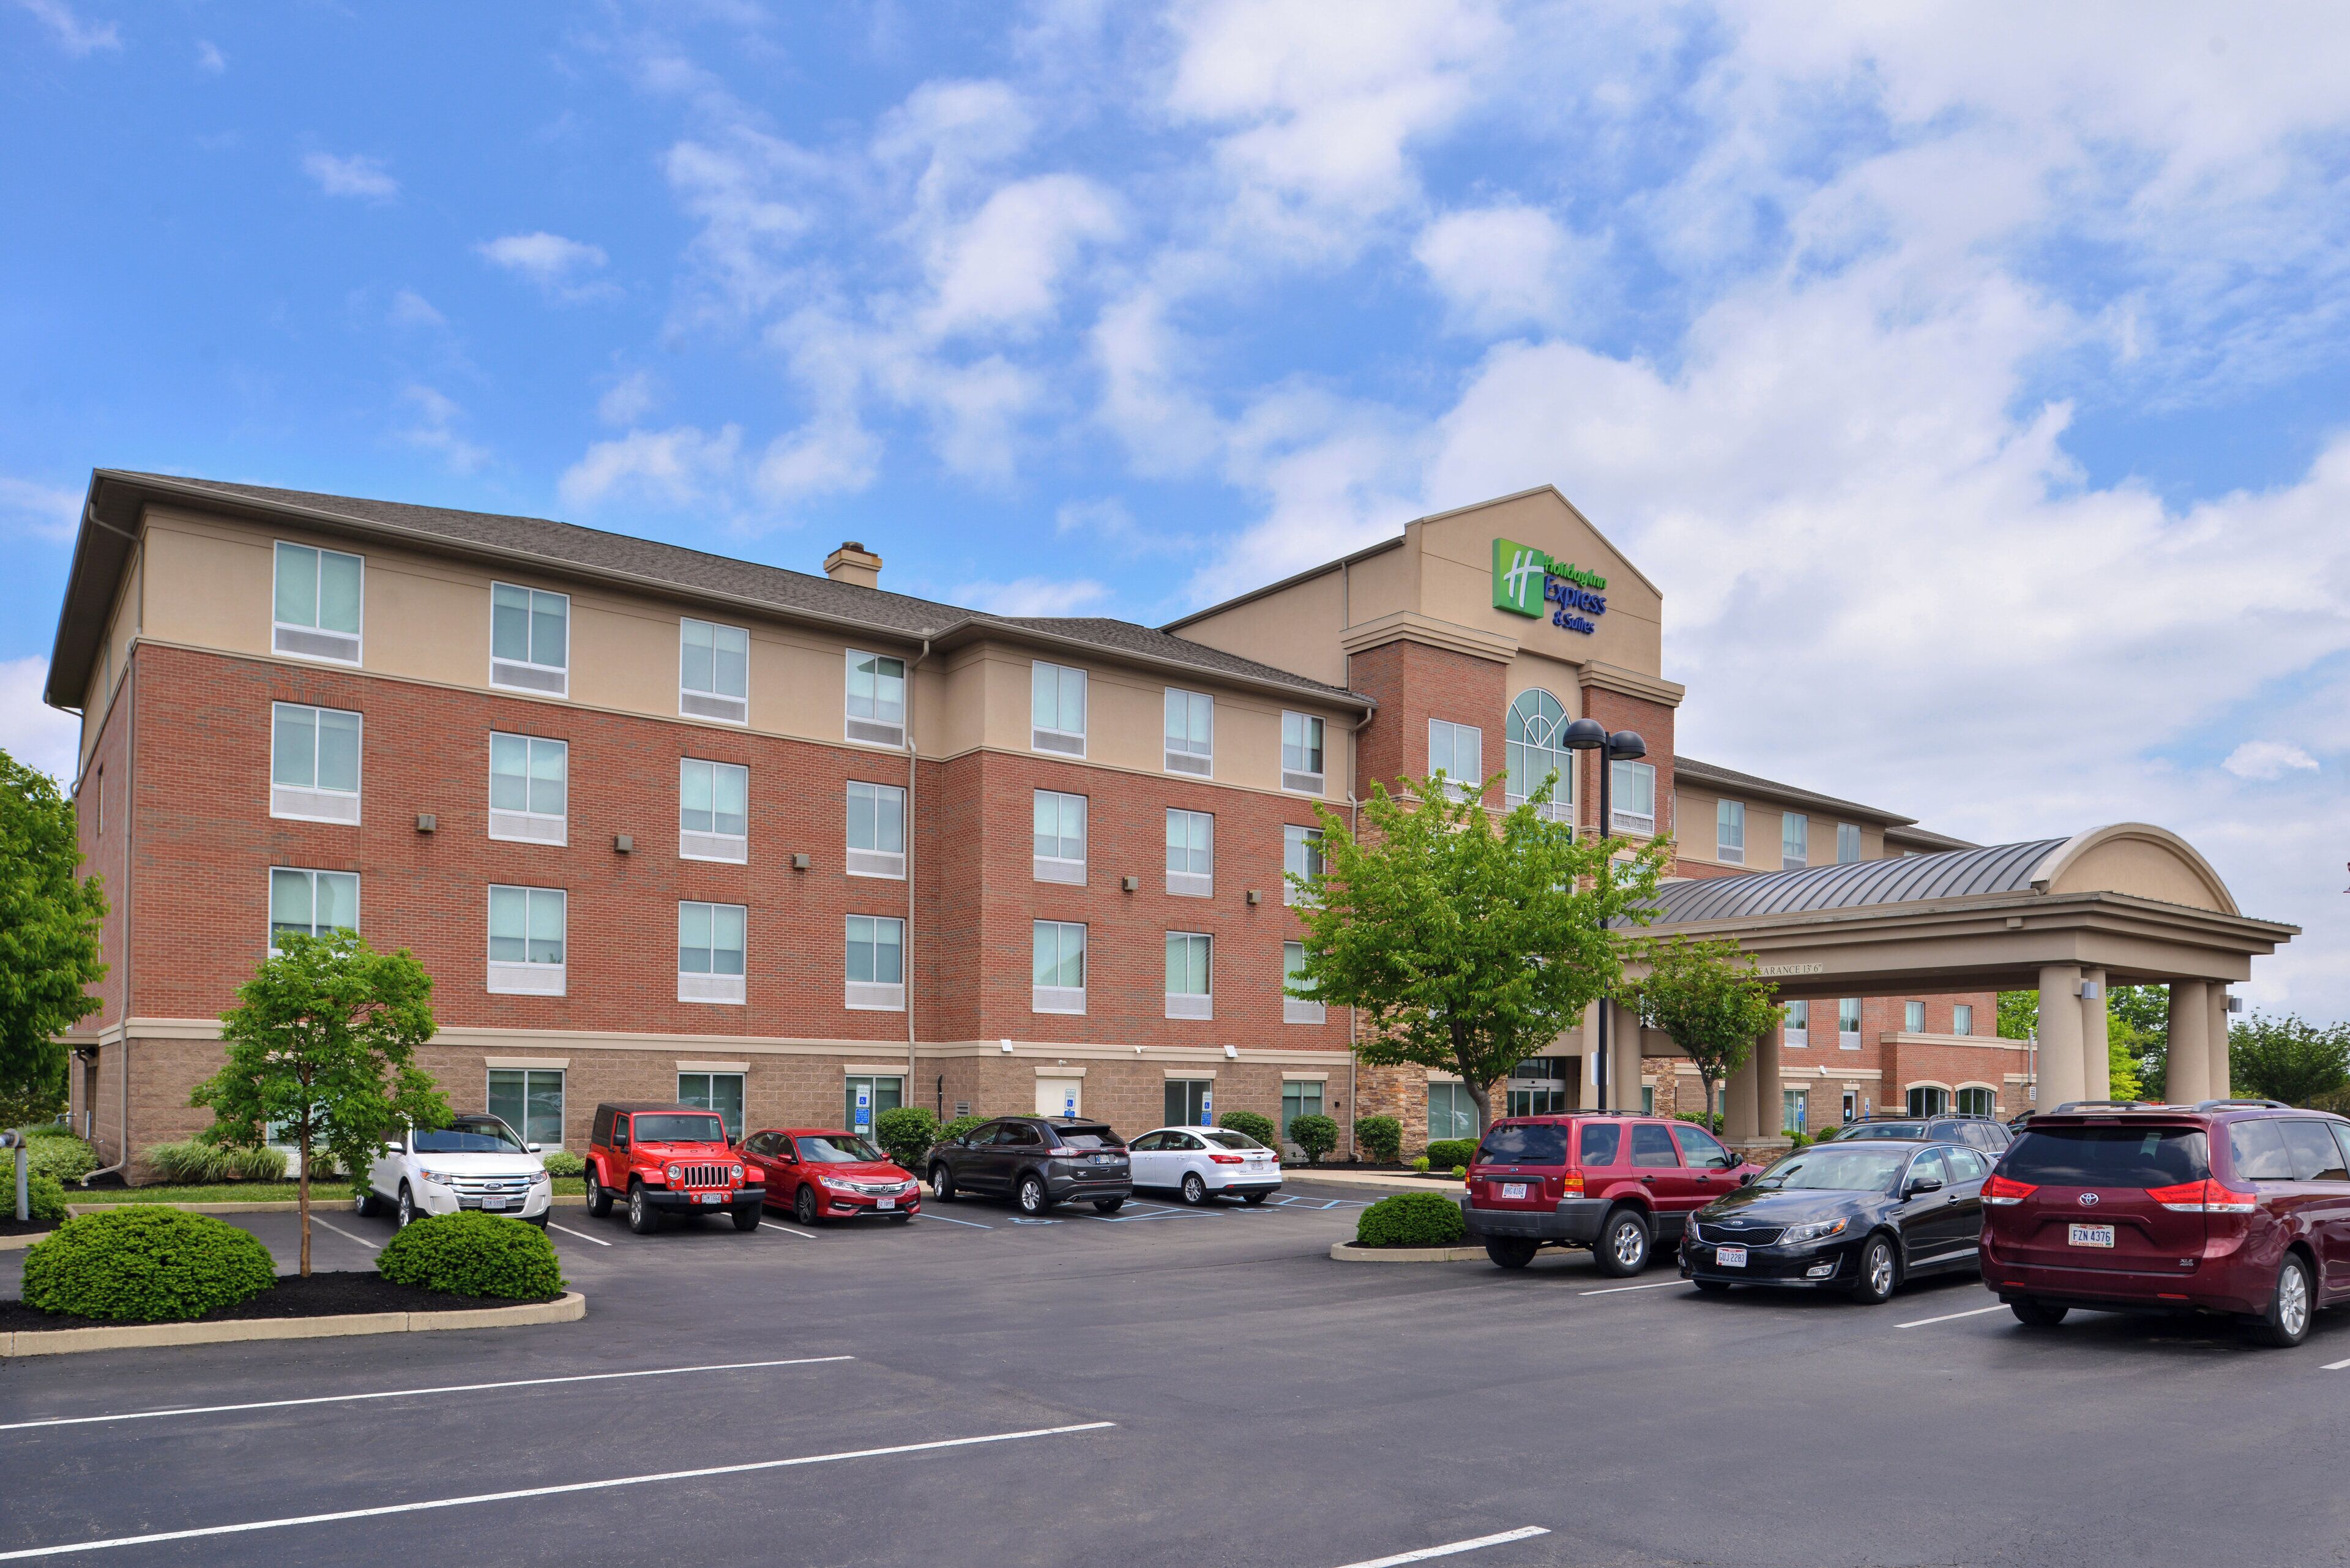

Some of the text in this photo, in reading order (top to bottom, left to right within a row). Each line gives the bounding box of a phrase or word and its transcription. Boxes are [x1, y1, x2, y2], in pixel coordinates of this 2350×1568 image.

[1544, 555, 1606, 589] Holiday Inn
[1544, 575, 1606, 615] Express
[1553, 610, 1595, 634] & Suites
[2073, 1230, 2111, 1242] FZN 4376
[1718, 1252, 1745, 1263] GUJ 2283
